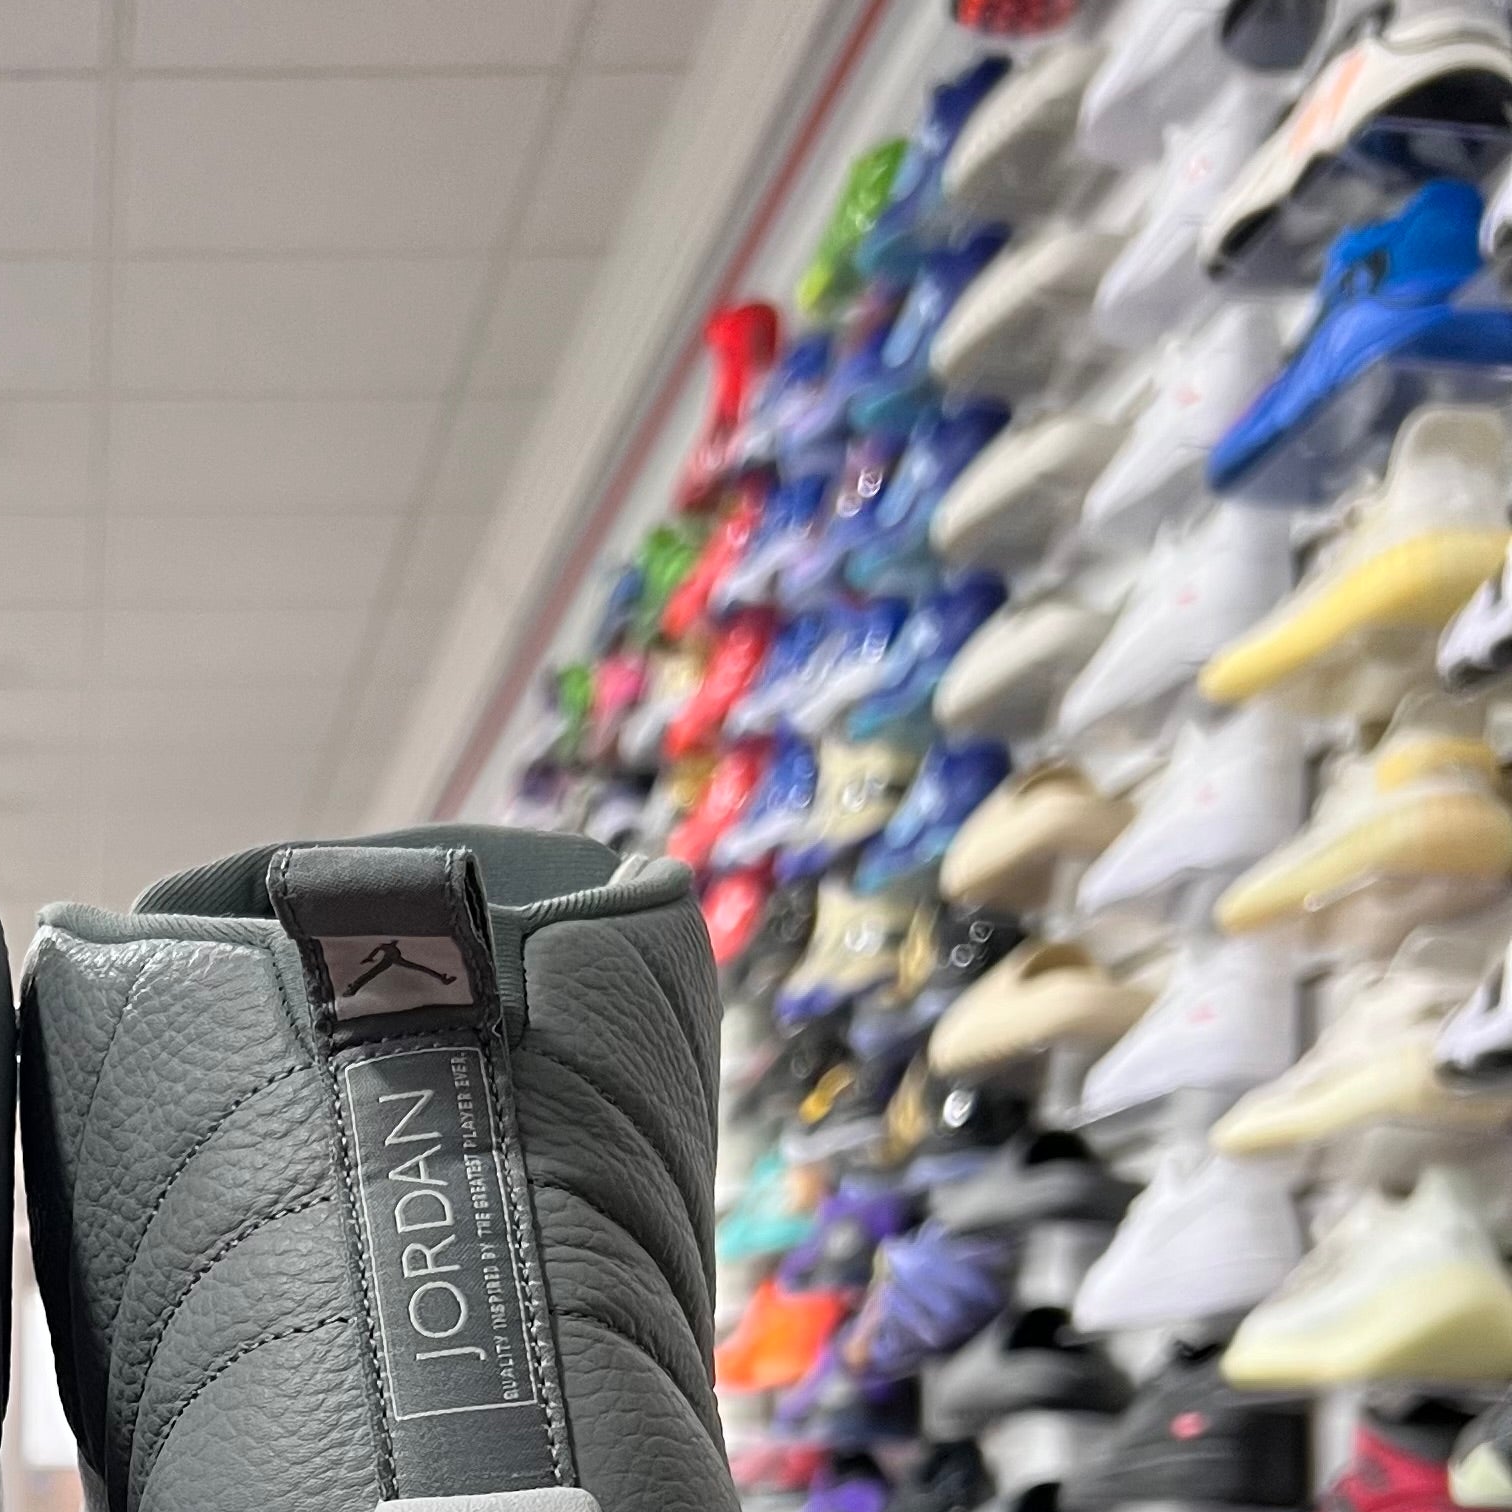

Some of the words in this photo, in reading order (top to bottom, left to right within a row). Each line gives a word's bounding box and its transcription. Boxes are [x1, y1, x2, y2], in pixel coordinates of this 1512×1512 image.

[457, 1093, 477, 1148] PLAYER
[463, 1154, 489, 1208] GREATEST
[377, 1089, 486, 1361] JORDAN
[475, 1213, 492, 1238] THE
[479, 1242, 496, 1260] BY
[483, 1265, 508, 1330] INSPIRED
[492, 1336, 519, 1400] QUALITY
